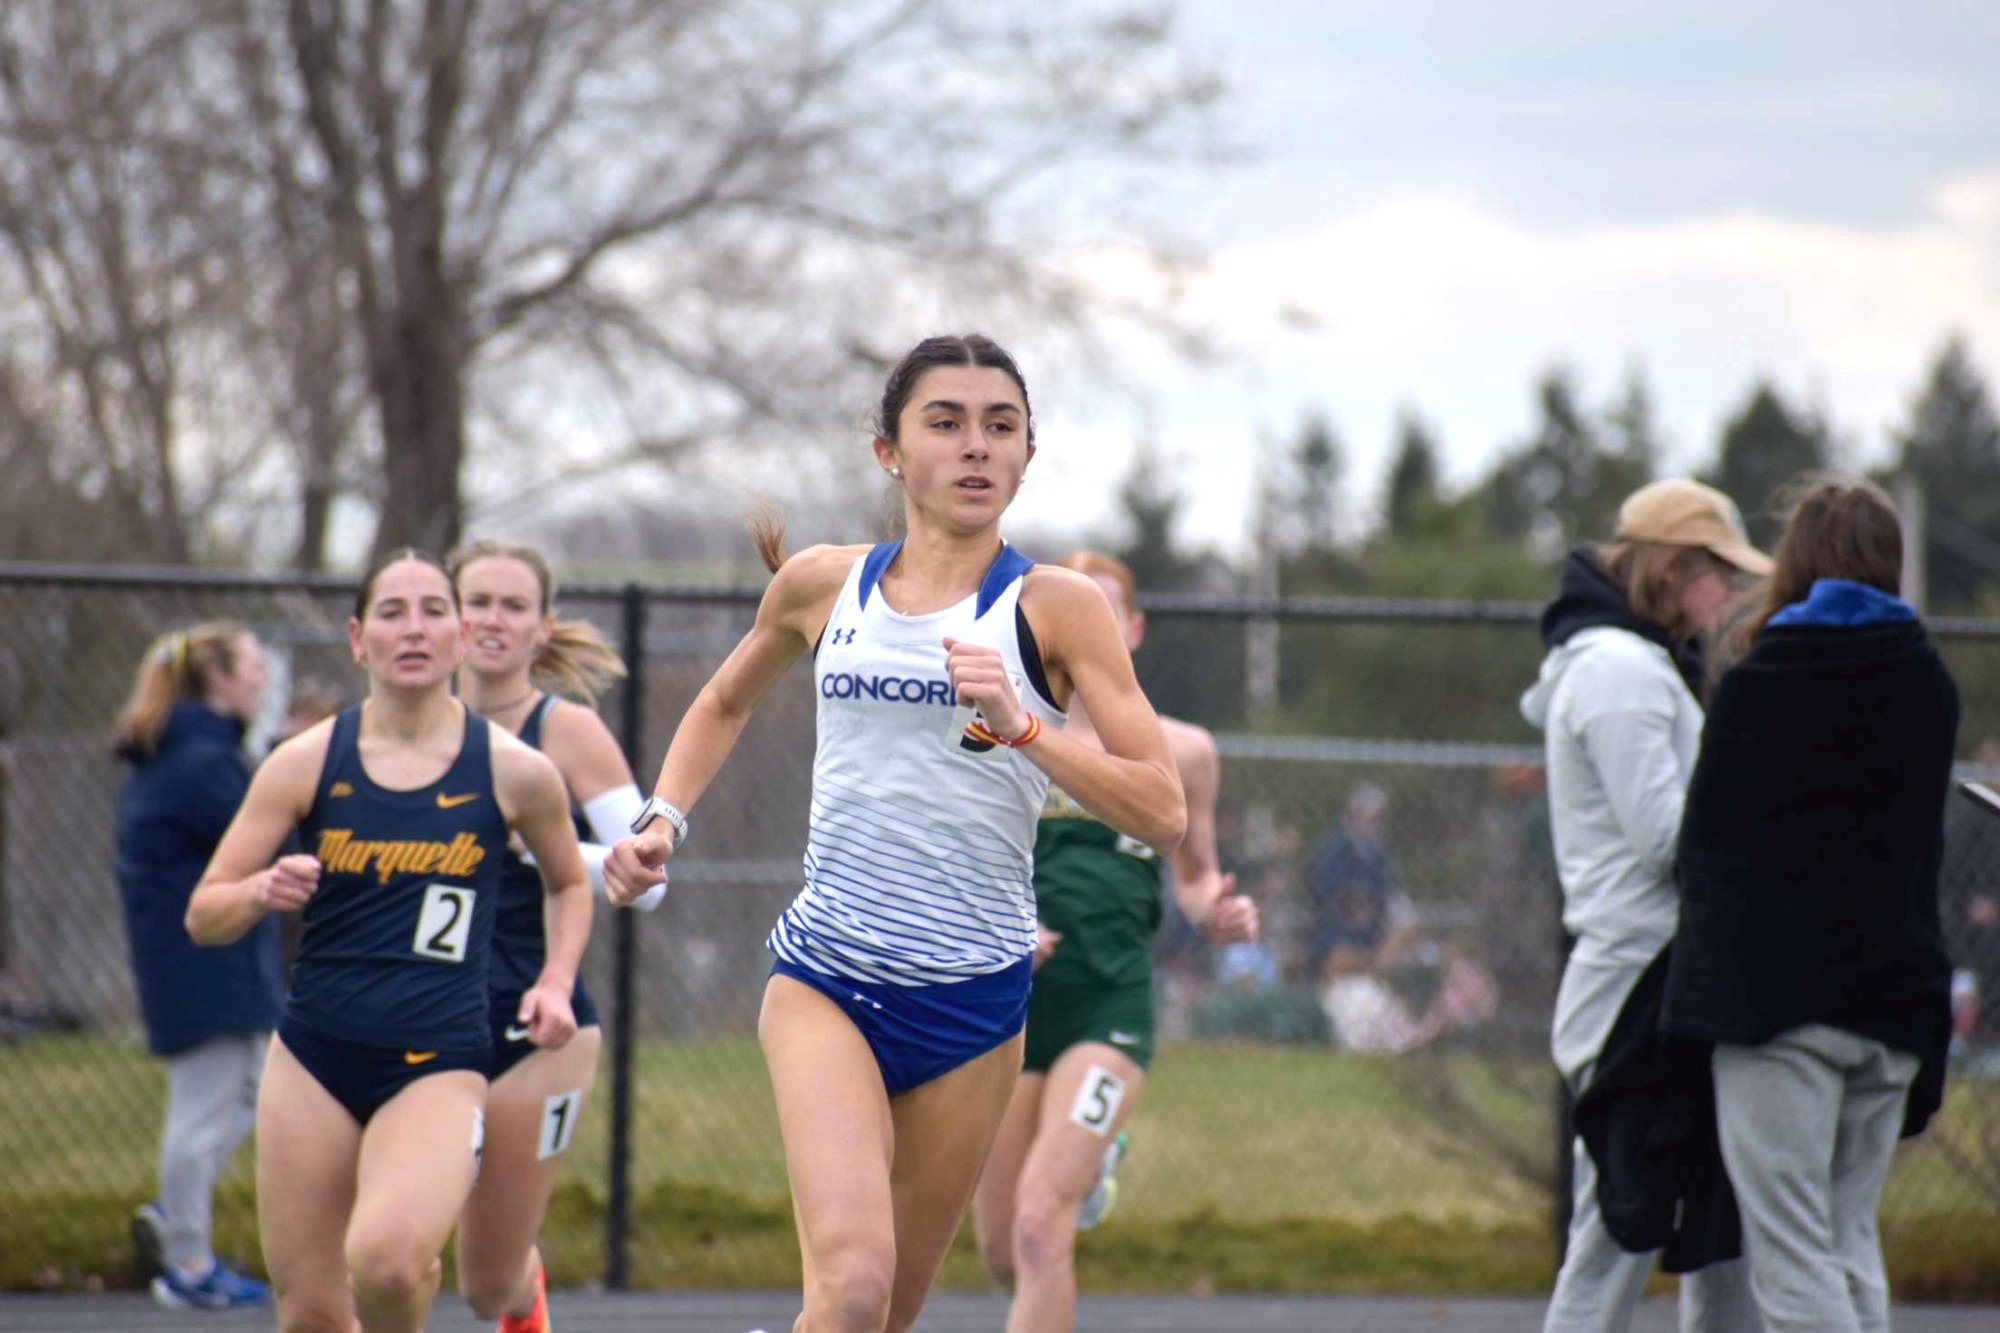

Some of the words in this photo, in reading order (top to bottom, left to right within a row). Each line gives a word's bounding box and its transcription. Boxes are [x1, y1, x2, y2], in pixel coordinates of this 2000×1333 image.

[318, 829, 485, 884] Marquette
[427, 892, 463, 953] 2
[552, 1097, 572, 1151] 1
[1083, 1075, 1117, 1125] 5
